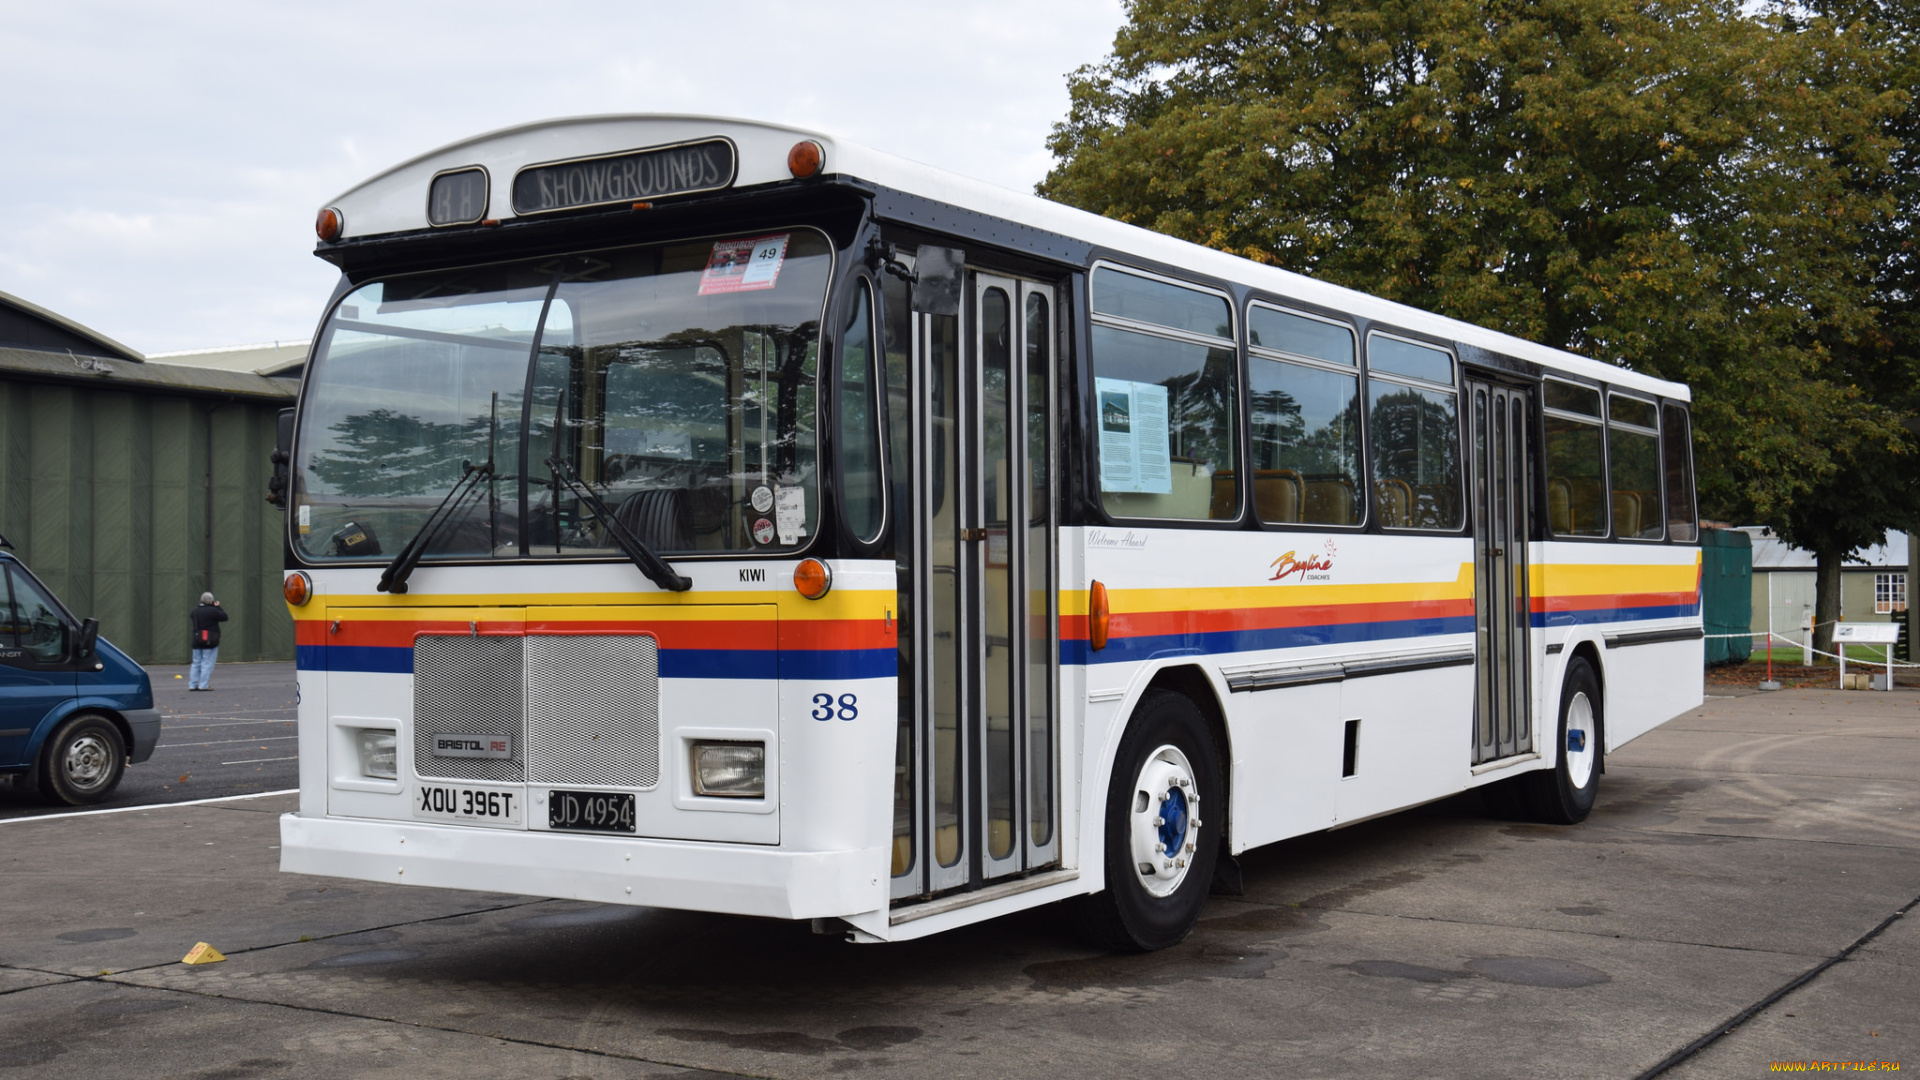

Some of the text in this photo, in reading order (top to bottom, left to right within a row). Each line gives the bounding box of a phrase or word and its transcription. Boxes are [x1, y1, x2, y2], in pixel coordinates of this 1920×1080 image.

[540, 149, 719, 209] SHOWGROUNDS
[759, 248, 776, 260] 49
[739, 568, 765, 582] KIWI
[1268, 550, 1333, 582] Bayline
[812, 693, 858, 721] 38
[438, 739, 506, 751] BRISTOL RE
[421, 787, 513, 818] XOU 396T
[553, 795, 631, 827] JD 4954
